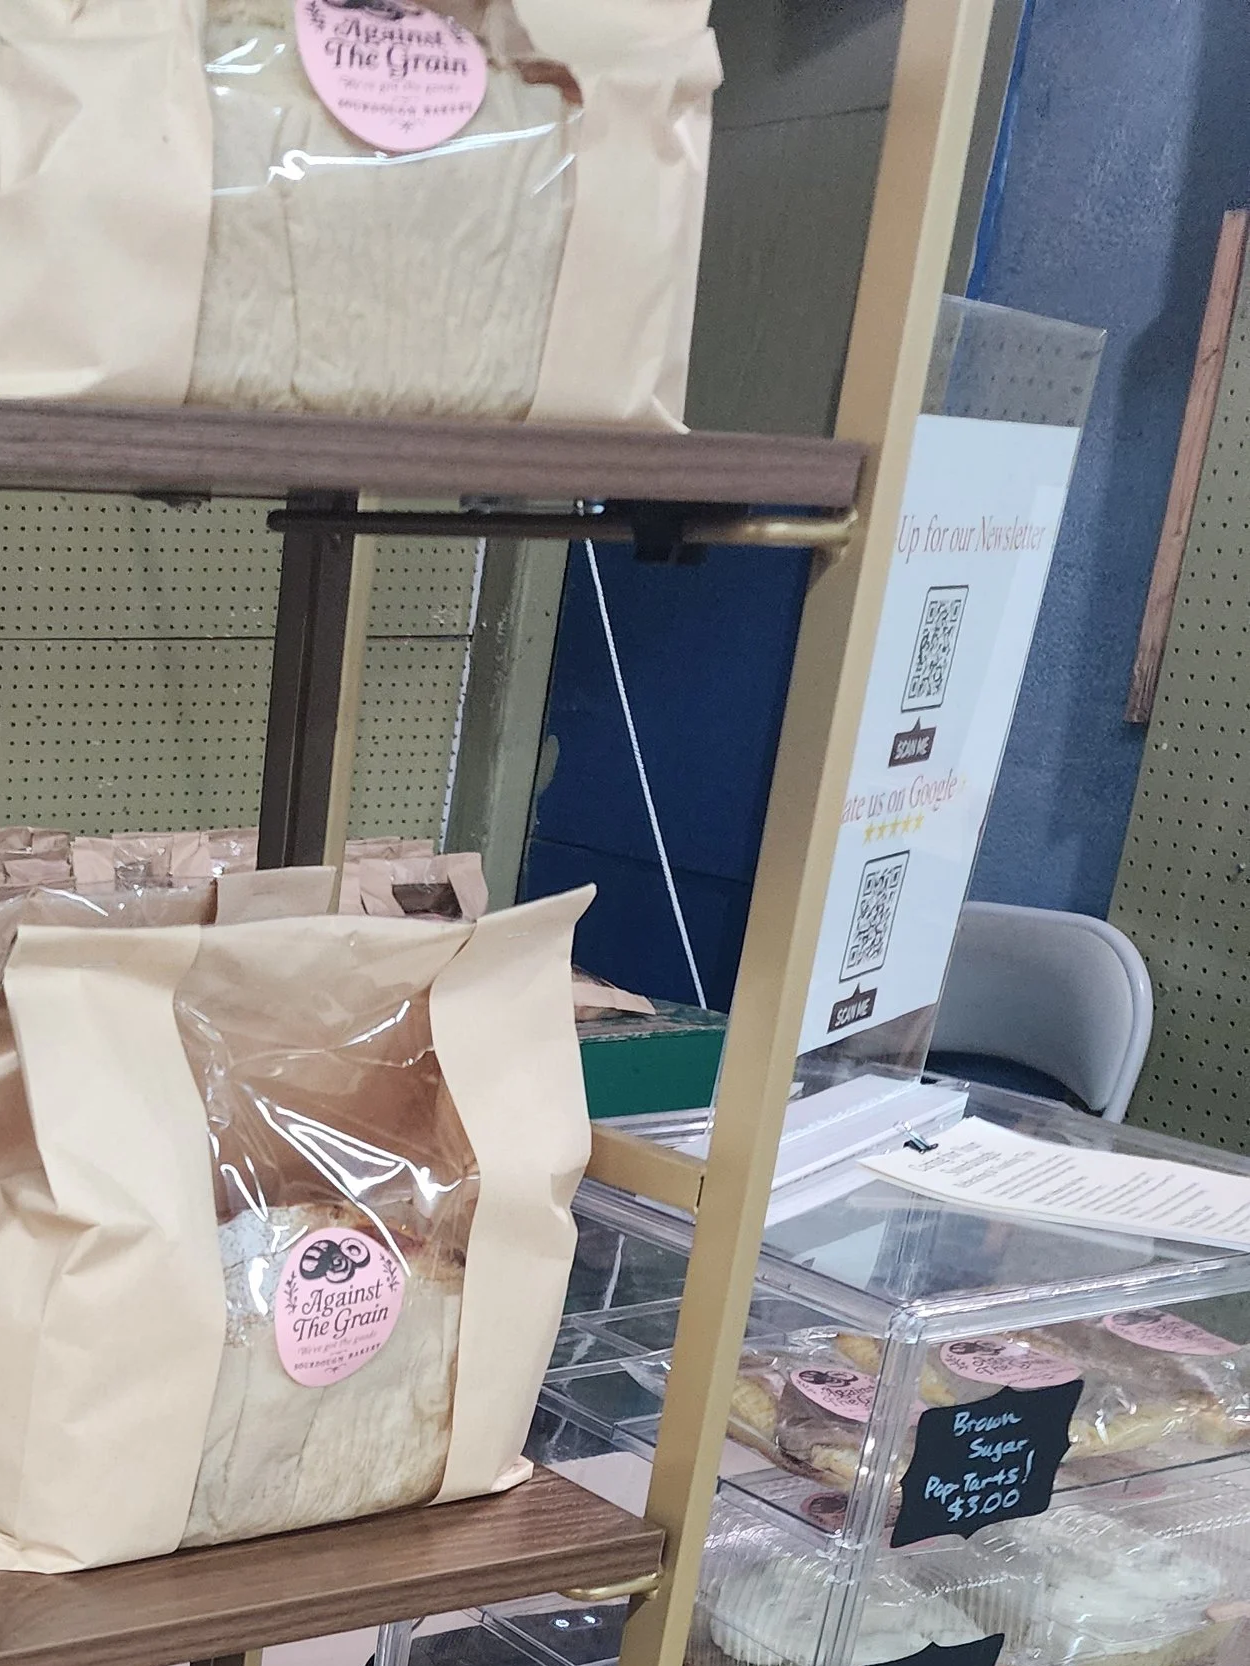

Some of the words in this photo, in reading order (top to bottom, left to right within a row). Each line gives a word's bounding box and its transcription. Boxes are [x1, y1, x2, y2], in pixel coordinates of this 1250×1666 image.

[334, 17, 442, 44] Against
[325, 37, 378, 68] The
[387, 43, 467, 77] Grain
[898, 515, 919, 564] Up
[924, 514, 949, 552] for
[950, 527, 975, 552] our
[975, 515, 1046, 552] Newsletter
[894, 738, 918, 760] SCAN
[914, 736, 930, 757] ME
[841, 794, 865, 824] ate
[868, 792, 885, 818] us
[887, 788, 906, 813] on
[910, 769, 957, 812] Google
[835, 1003, 858, 1027] SCAN
[856, 998, 870, 1019] ME
[302, 1279, 382, 1317] Against
[293, 1316, 330, 1342] The
[333, 1303, 389, 1339] Grain
[954, 1410, 1022, 1437] Brown
[968, 1437, 1030, 1463] Sugar
[924, 1475, 960, 1505] Pop
